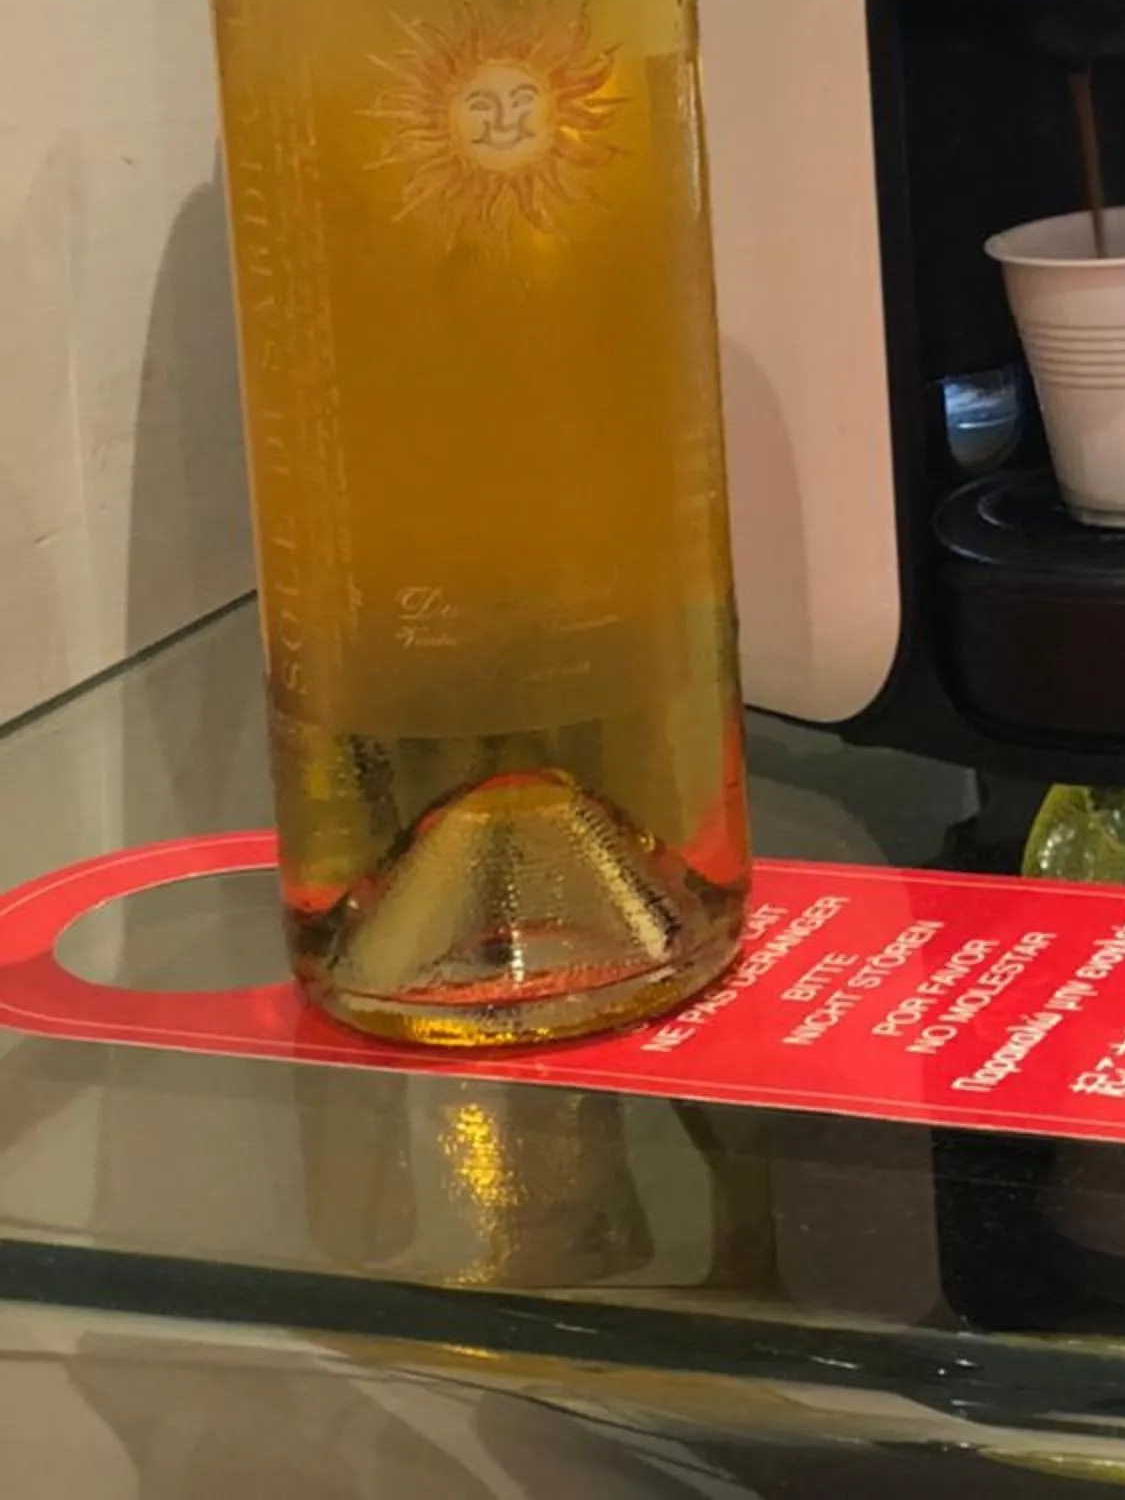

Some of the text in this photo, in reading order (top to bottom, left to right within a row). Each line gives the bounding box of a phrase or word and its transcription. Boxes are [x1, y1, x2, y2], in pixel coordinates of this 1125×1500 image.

[742, 904, 789, 941] LAIT
[781, 952, 859, 1002] BITTE
[872, 939, 999, 1037] POR FAVOR
[906, 930, 1058, 1055] NO MOLESTAR
[641, 1025, 696, 1053] NE
[677, 989, 738, 1024] PAS
[782, 989, 863, 1046] NICHT
